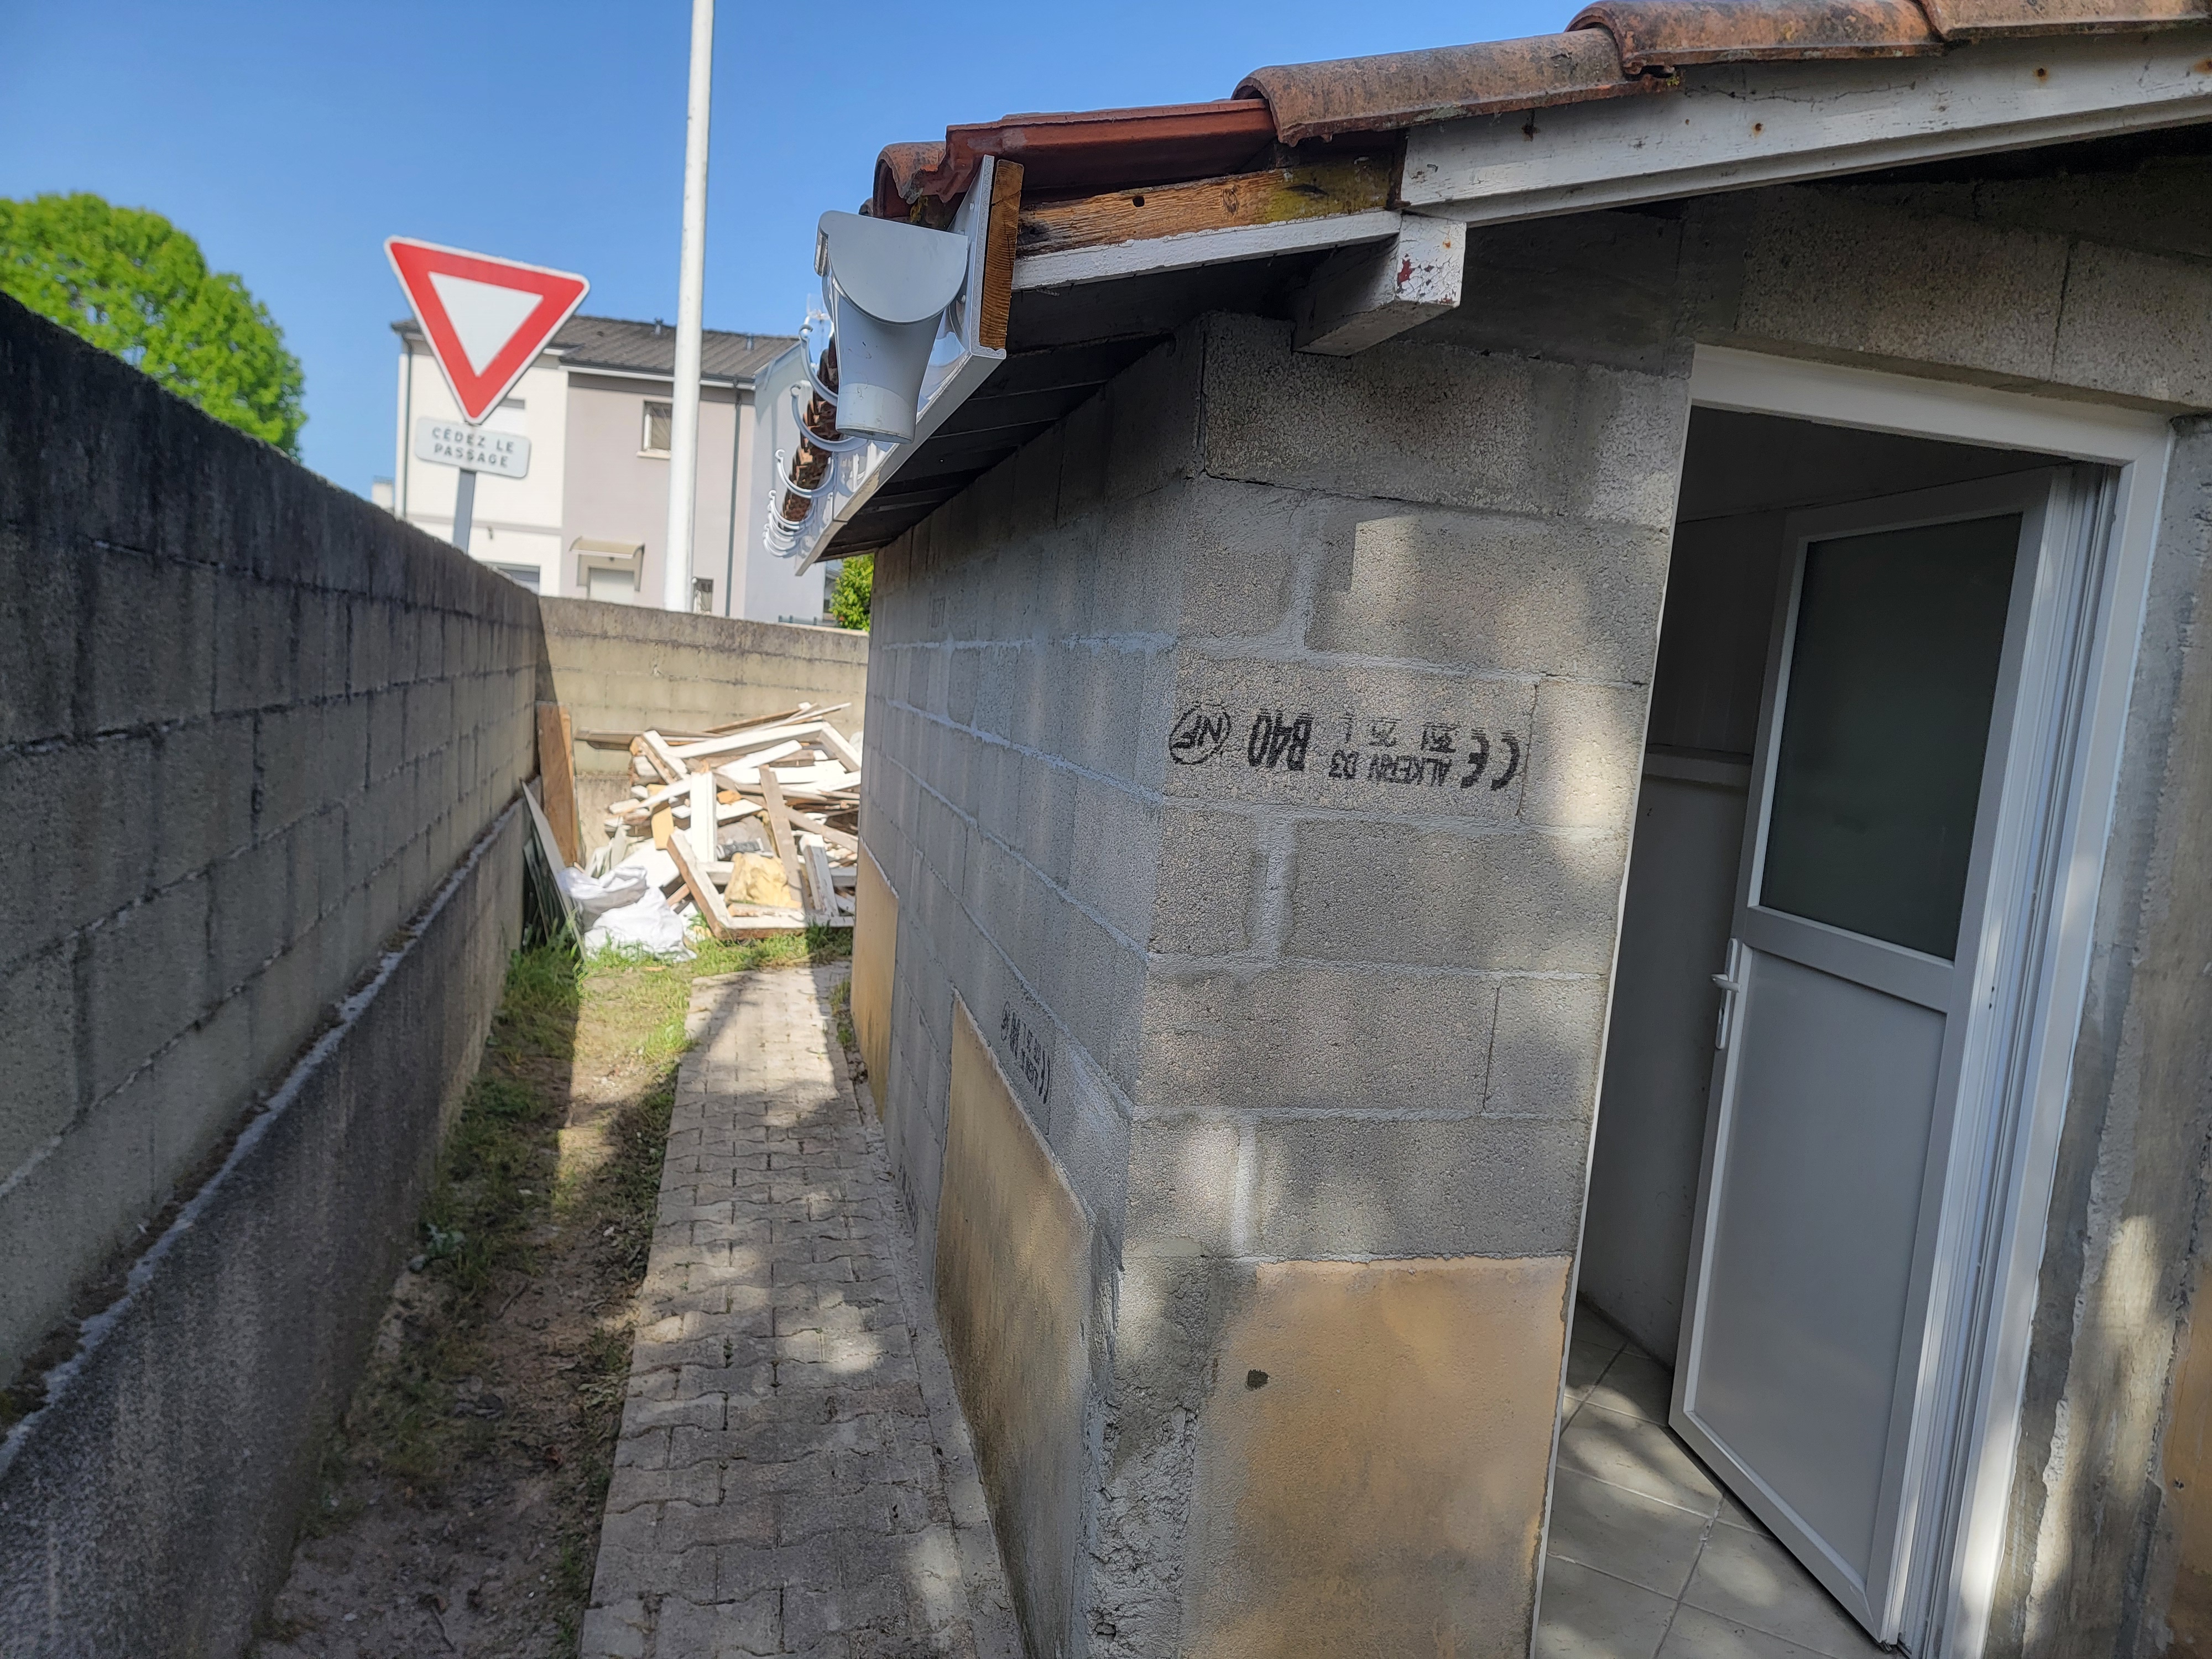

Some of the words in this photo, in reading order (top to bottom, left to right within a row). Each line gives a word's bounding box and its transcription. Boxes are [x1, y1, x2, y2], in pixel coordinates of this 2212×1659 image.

[434, 443, 508, 468] PASSAGE
[497, 439, 514, 452] LE
[1248, 709, 1312, 770] B40
